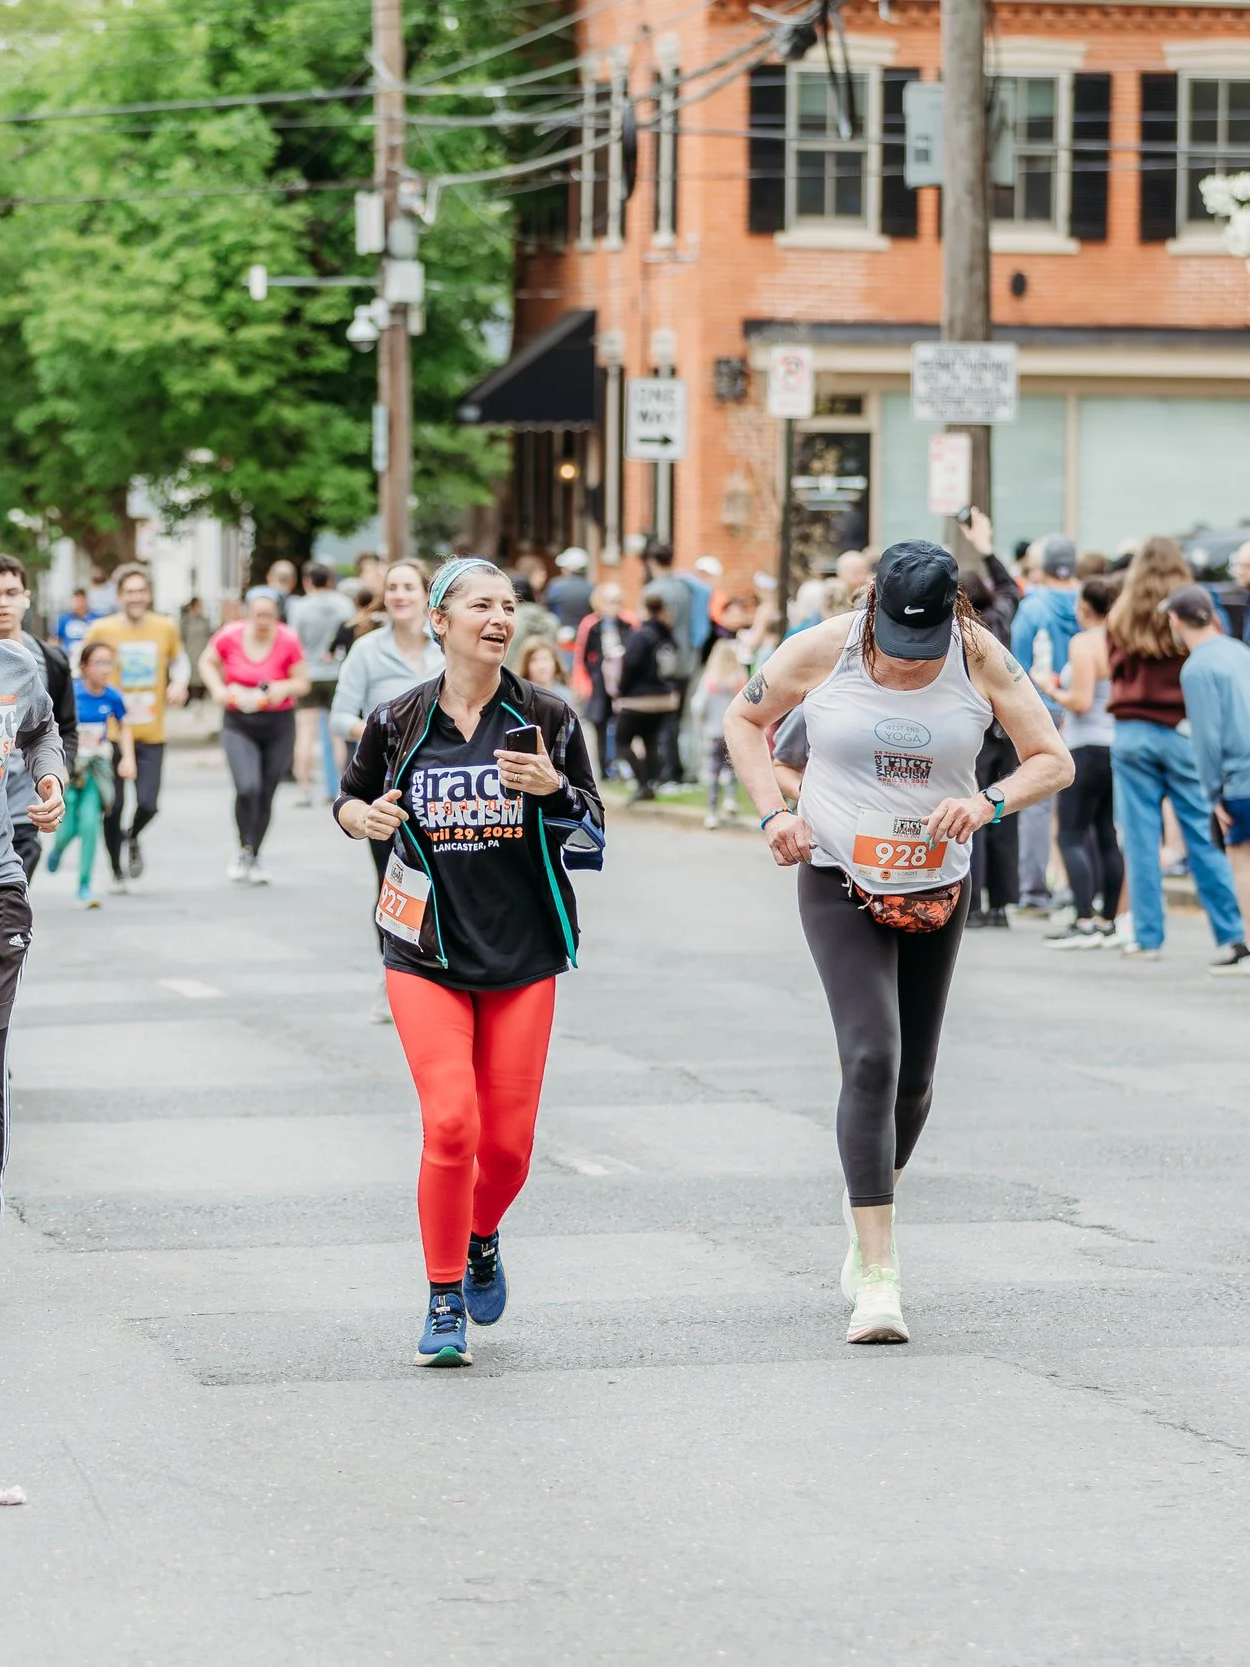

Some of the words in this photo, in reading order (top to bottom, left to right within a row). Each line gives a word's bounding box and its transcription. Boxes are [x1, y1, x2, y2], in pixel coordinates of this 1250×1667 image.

[885, 731, 922, 744] YOGA
[884, 770, 930, 779] RACISM
[429, 794, 522, 815] against
[427, 802, 523, 828] RACISM
[454, 827, 479, 841] 29,
[483, 826, 523, 839] 2023
[433, 842, 487, 853] LANCASTER,
[488, 840, 500, 848] PA
[875, 842, 927, 867] 928
[380, 884, 408, 918] 927
